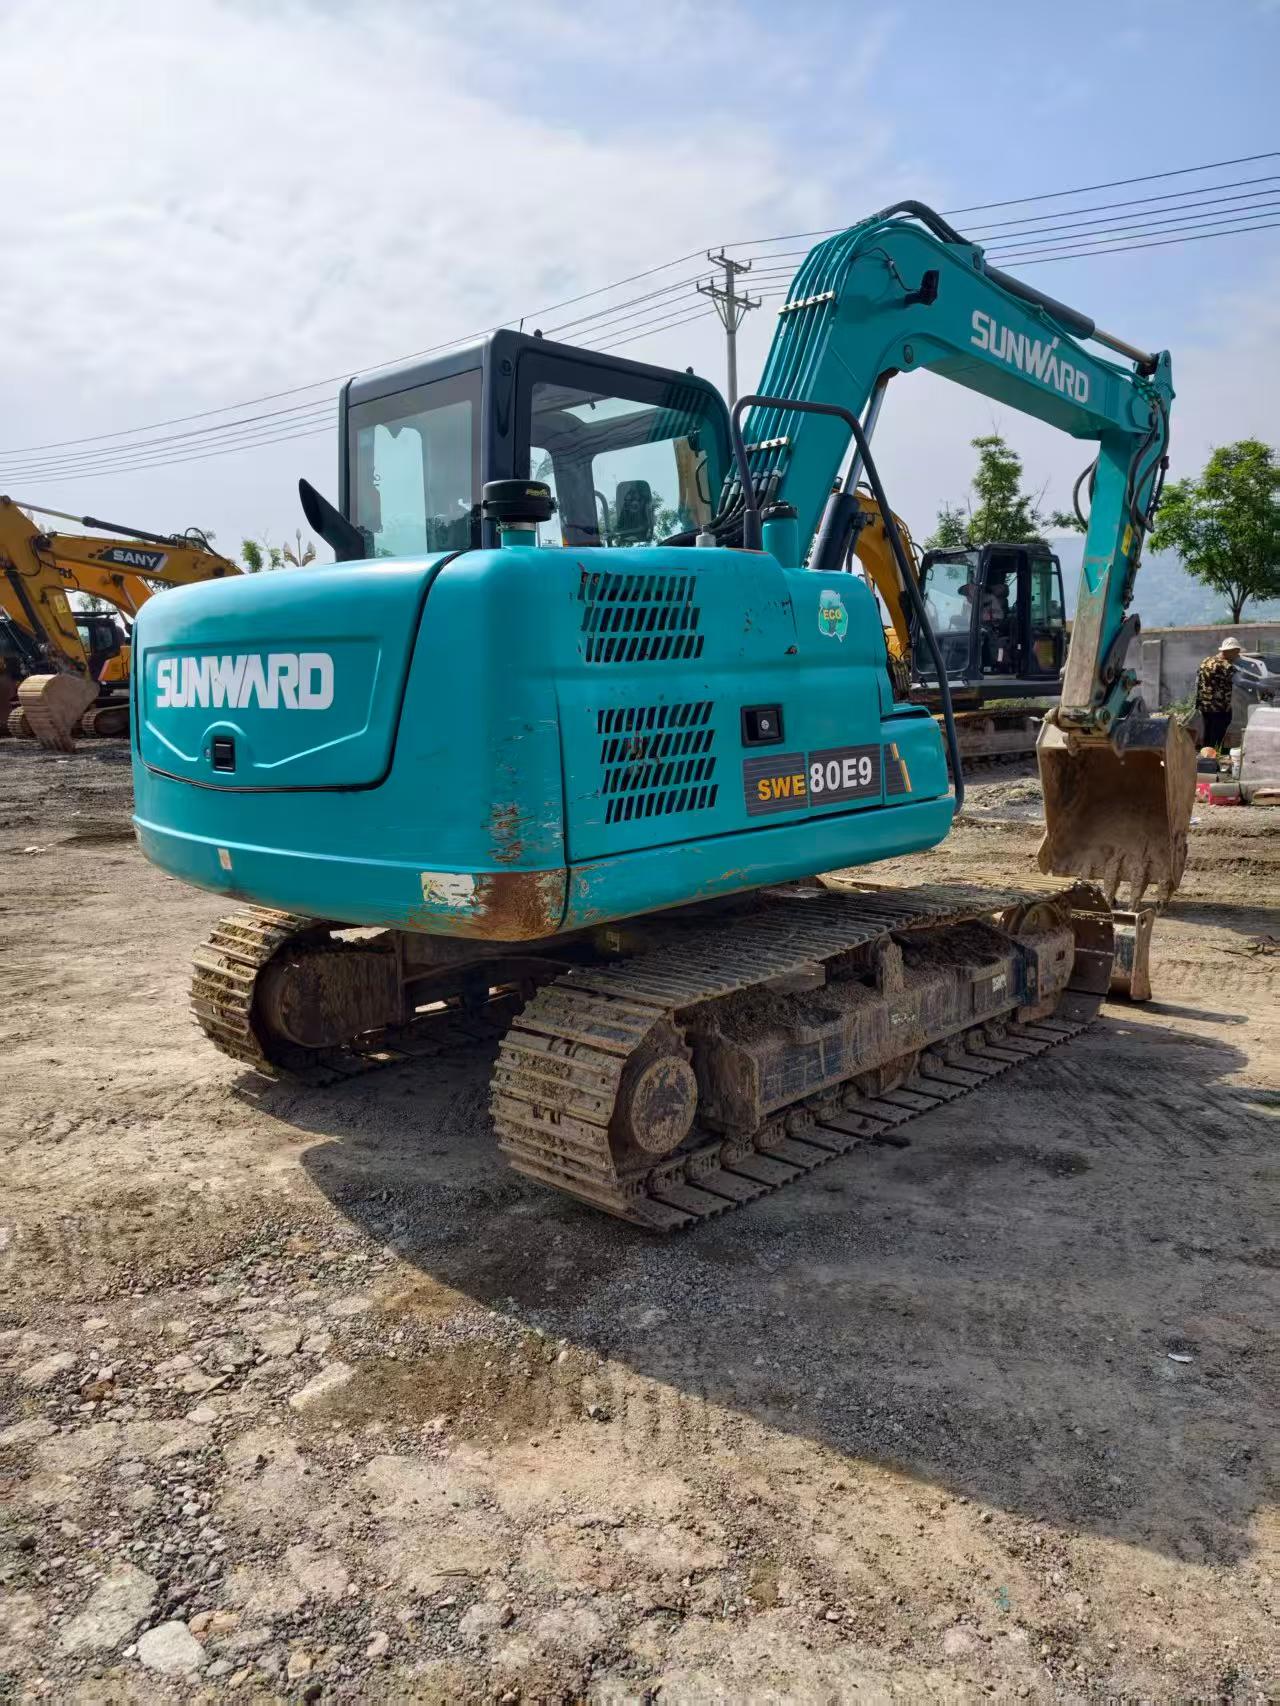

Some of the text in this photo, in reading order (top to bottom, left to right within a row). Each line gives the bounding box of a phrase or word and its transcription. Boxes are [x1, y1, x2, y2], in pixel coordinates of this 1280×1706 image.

[971, 310, 1089, 404] SUNWARD
[113, 549, 157, 567] SANY
[823, 608, 842, 621] ECO
[157, 652, 335, 710] SUNWARD
[757, 757, 873, 801] SWE 80E9
